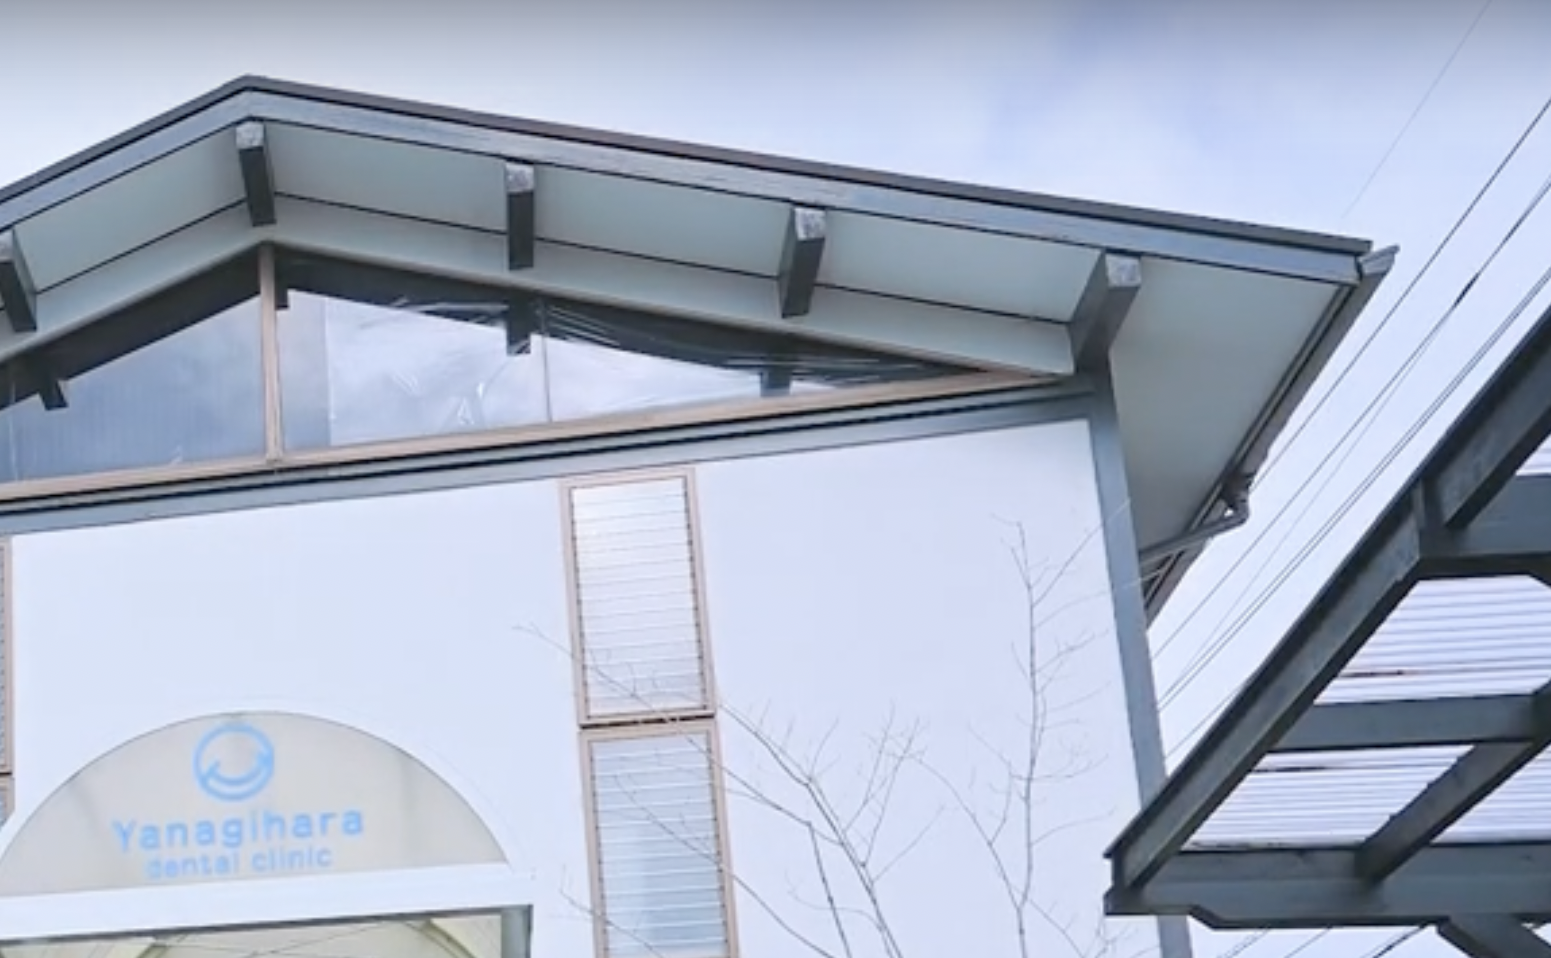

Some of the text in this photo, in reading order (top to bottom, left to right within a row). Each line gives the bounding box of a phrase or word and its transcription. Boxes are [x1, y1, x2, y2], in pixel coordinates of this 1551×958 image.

[112, 809, 363, 850] Yanagihara
[147, 846, 332, 878] dental clinic
